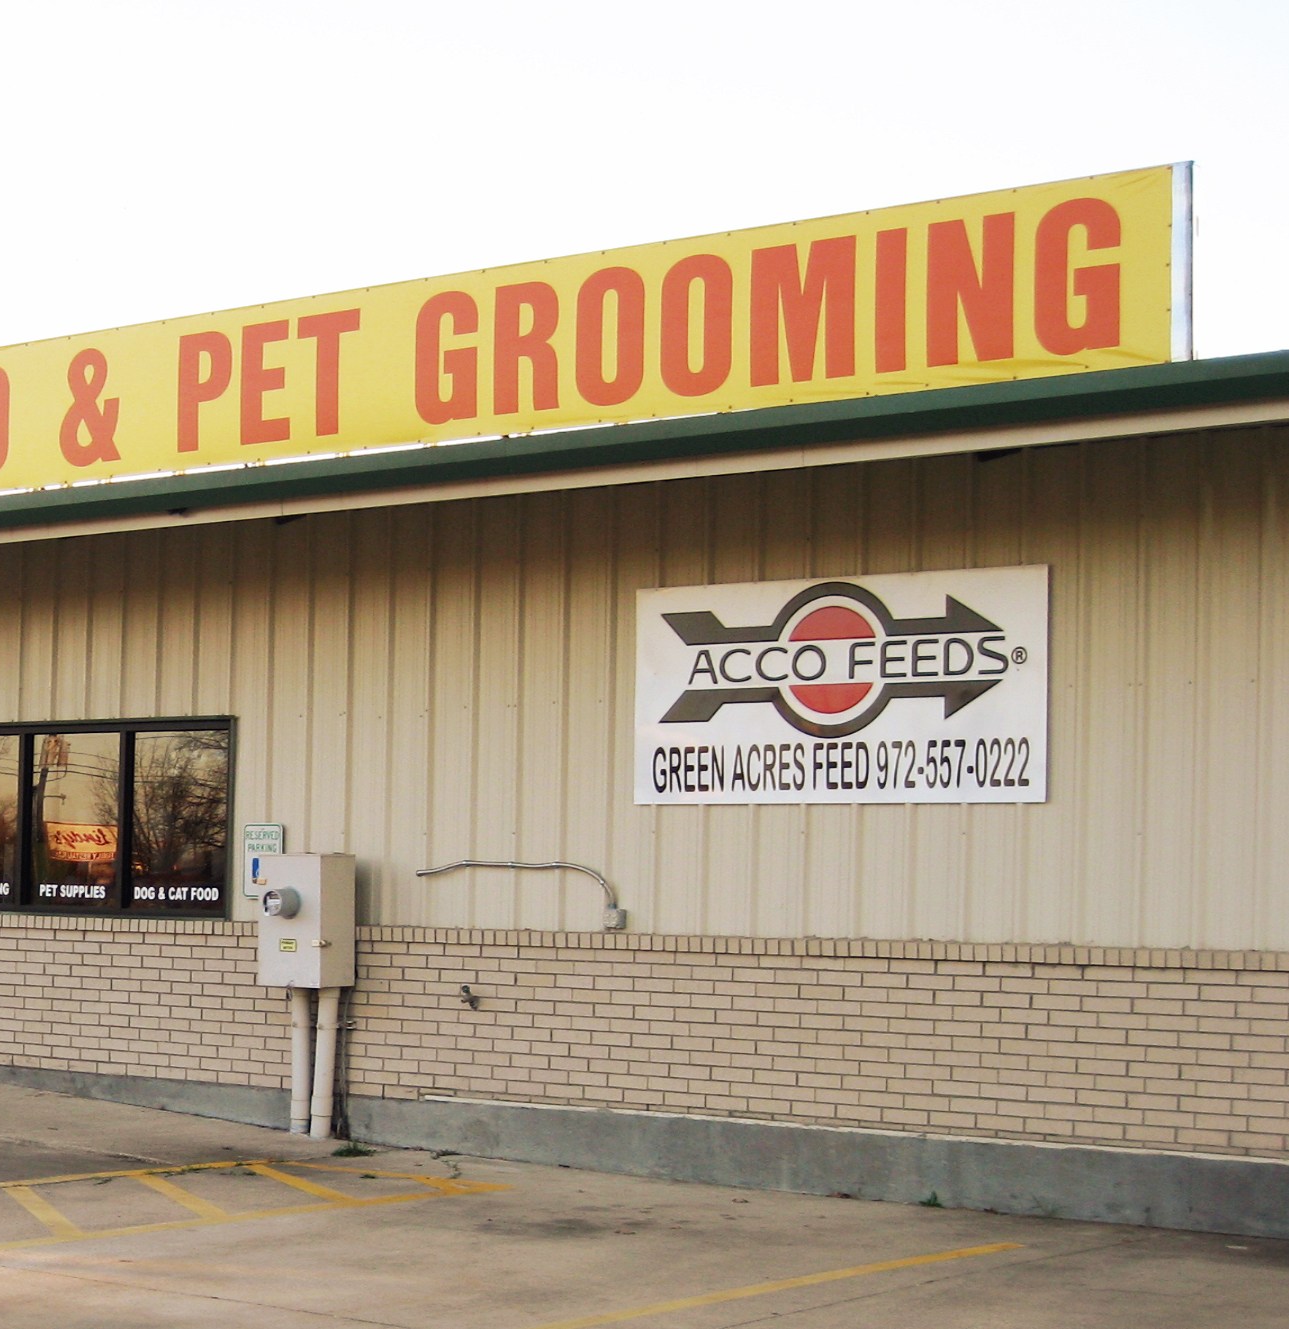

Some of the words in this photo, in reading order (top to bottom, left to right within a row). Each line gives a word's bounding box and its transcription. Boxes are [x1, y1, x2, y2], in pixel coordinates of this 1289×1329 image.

[59, 347, 121, 467] &
[177, 307, 361, 453] PET
[414, 196, 1122, 426] GROOMING
[688, 644, 827, 686] ACCO
[848, 635, 1009, 680] FEEDS
[652, 746, 725, 793] GREEN
[731, 742, 806, 791] ACRES
[812, 741, 870, 790] FEED
[876, 737, 1031, 789] 972-557-0222
[245, 830, 280, 840] RESERVED
[247, 843, 277, 853] PARKING
[39, 884, 58, 896] PET
[59, 885, 106, 899] SUPPLIES
[134, 886, 155, 900] DOG
[158, 888, 166, 900] &
[168, 887, 188, 901] CAT
[190, 887, 219, 901] FOOD
